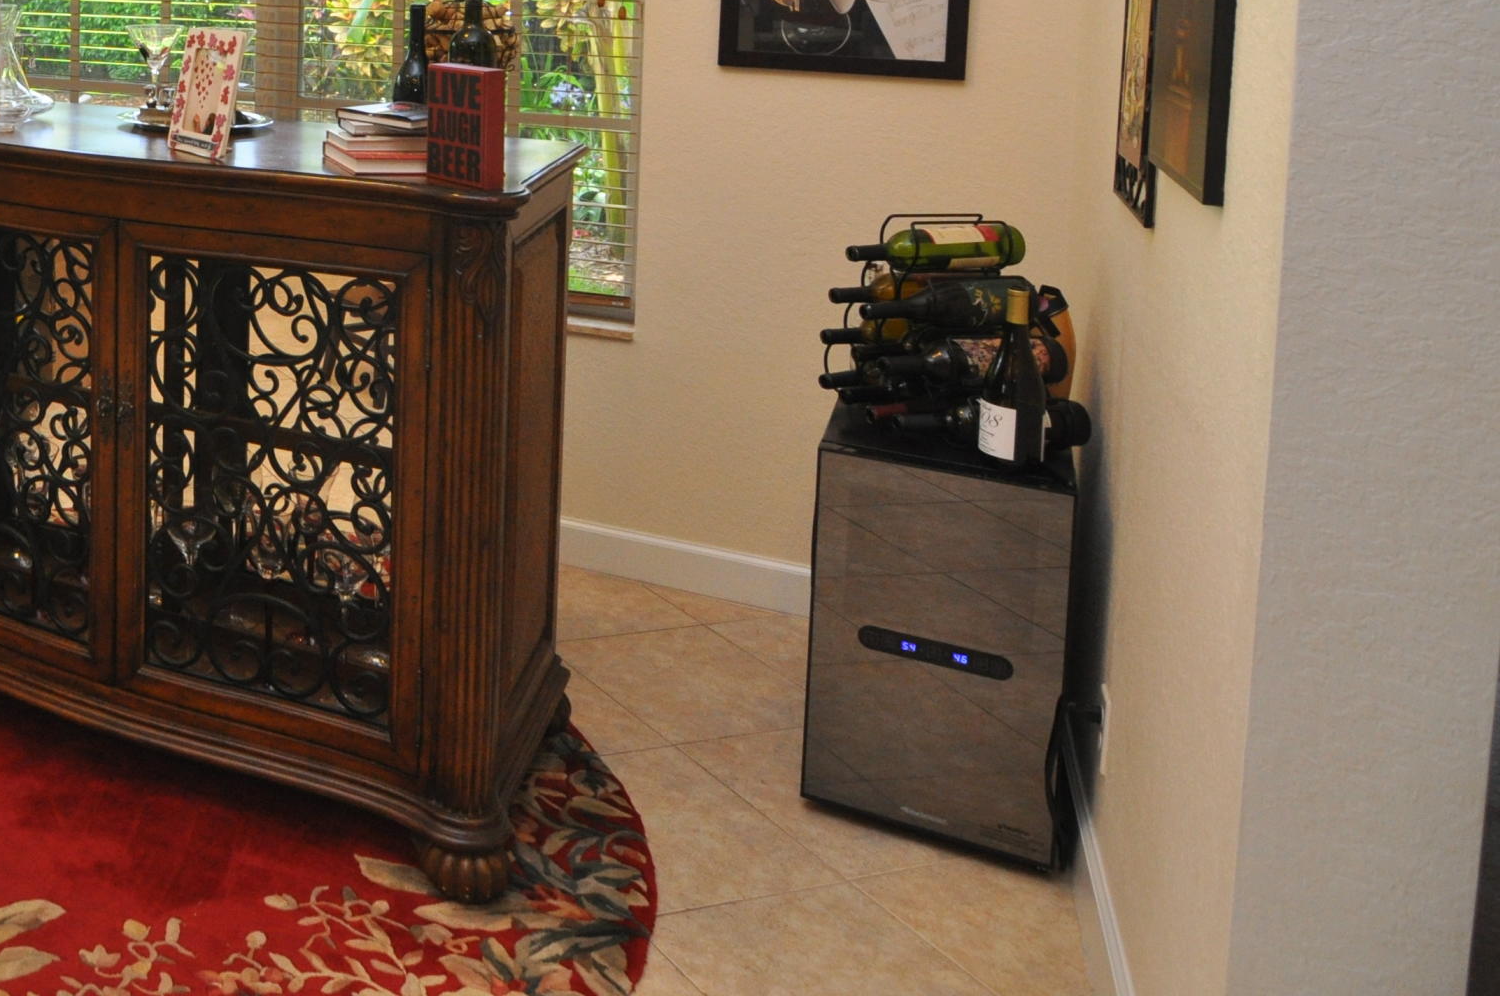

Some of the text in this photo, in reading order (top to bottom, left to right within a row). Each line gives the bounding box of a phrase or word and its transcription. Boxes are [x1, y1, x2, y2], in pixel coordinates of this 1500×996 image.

[428, 70, 482, 110] LIVE
[428, 107, 482, 146] LAUGH
[428, 142, 481, 182] BEER
